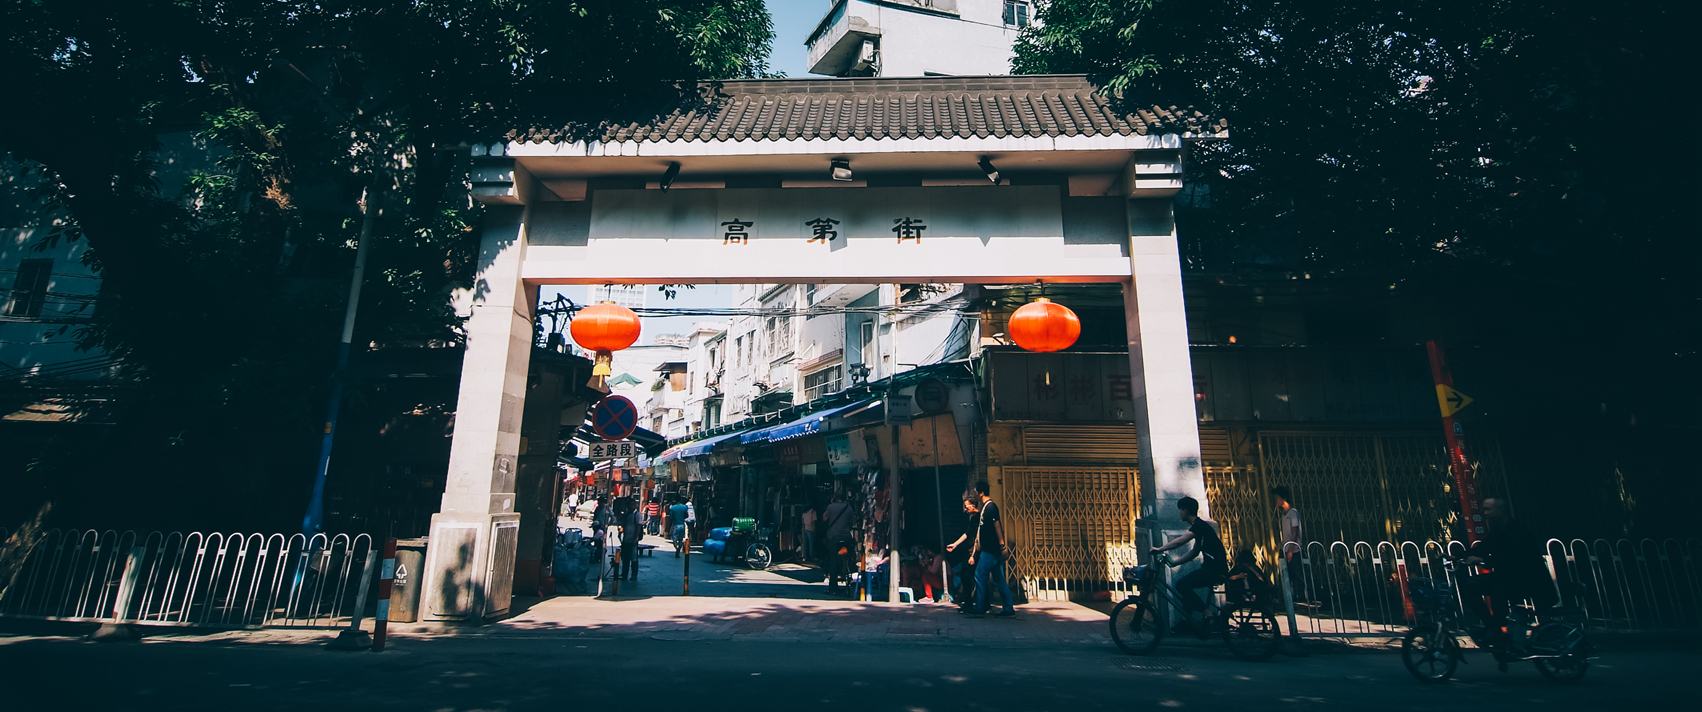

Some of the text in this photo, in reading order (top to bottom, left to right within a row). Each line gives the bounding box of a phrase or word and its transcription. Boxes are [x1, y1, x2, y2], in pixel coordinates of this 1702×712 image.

[721, 217, 926, 245] 高第街
[592, 443, 632, 458] 全路段
